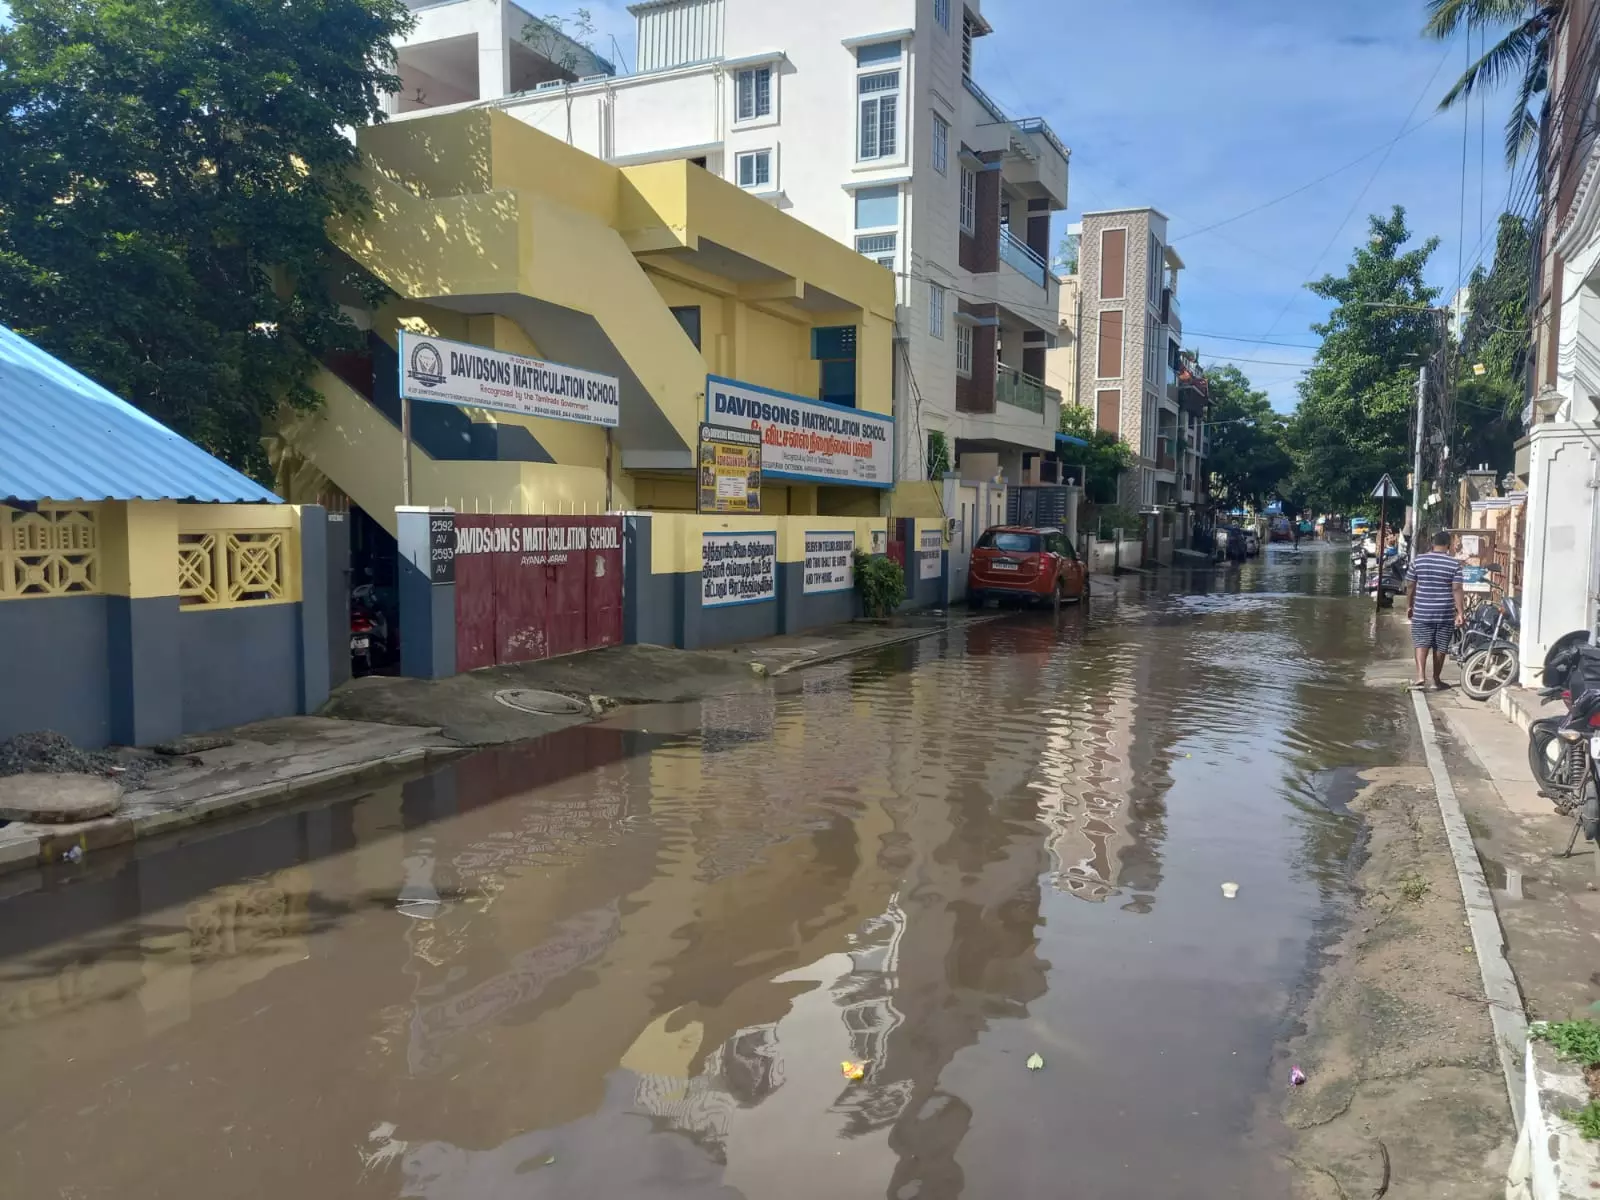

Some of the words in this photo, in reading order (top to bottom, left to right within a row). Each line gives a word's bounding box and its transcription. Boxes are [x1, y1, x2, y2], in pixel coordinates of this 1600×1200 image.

[450, 350, 511, 386] DAVIDSONS
[513, 364, 585, 400] MATRICULATION
[586, 379, 618, 406] SCHOOL
[515, 390, 522, 401] by
[524, 391, 534, 401] the
[715, 392, 800, 426] DAVIDSONS
[801, 411, 860, 437] MATRICULATION
[861, 423, 886, 441] SCHOOL
[431, 520, 454, 532] 2592
[435, 534, 447, 544] AV
[590, 526, 620, 549] SCHOOL
[431, 547, 454, 560] 2593
[435, 564, 447, 574] AV
